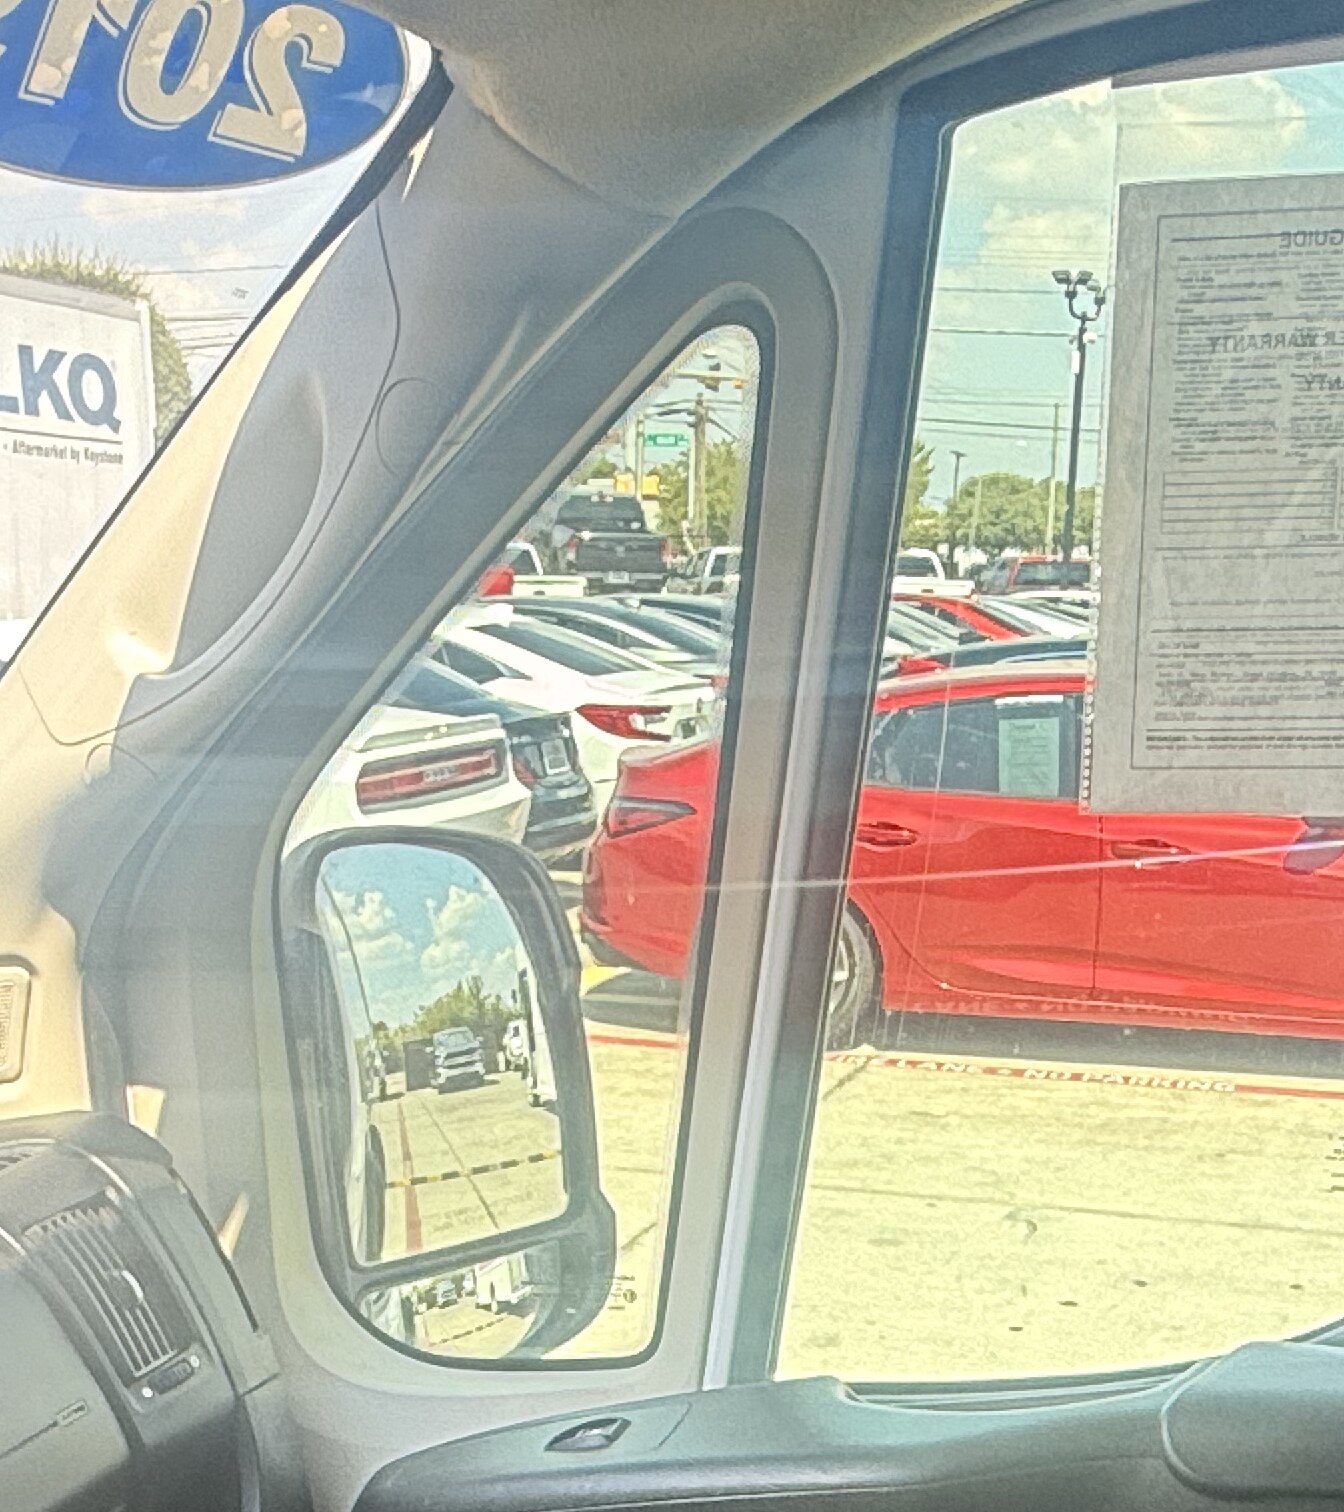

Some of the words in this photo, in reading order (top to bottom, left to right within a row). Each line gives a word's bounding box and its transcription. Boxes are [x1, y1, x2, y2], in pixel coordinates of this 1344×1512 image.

[12, 438, 68, 460] Aftermarket
[70, 446, 80, 464] by
[84, 447, 123, 467] Keystone
